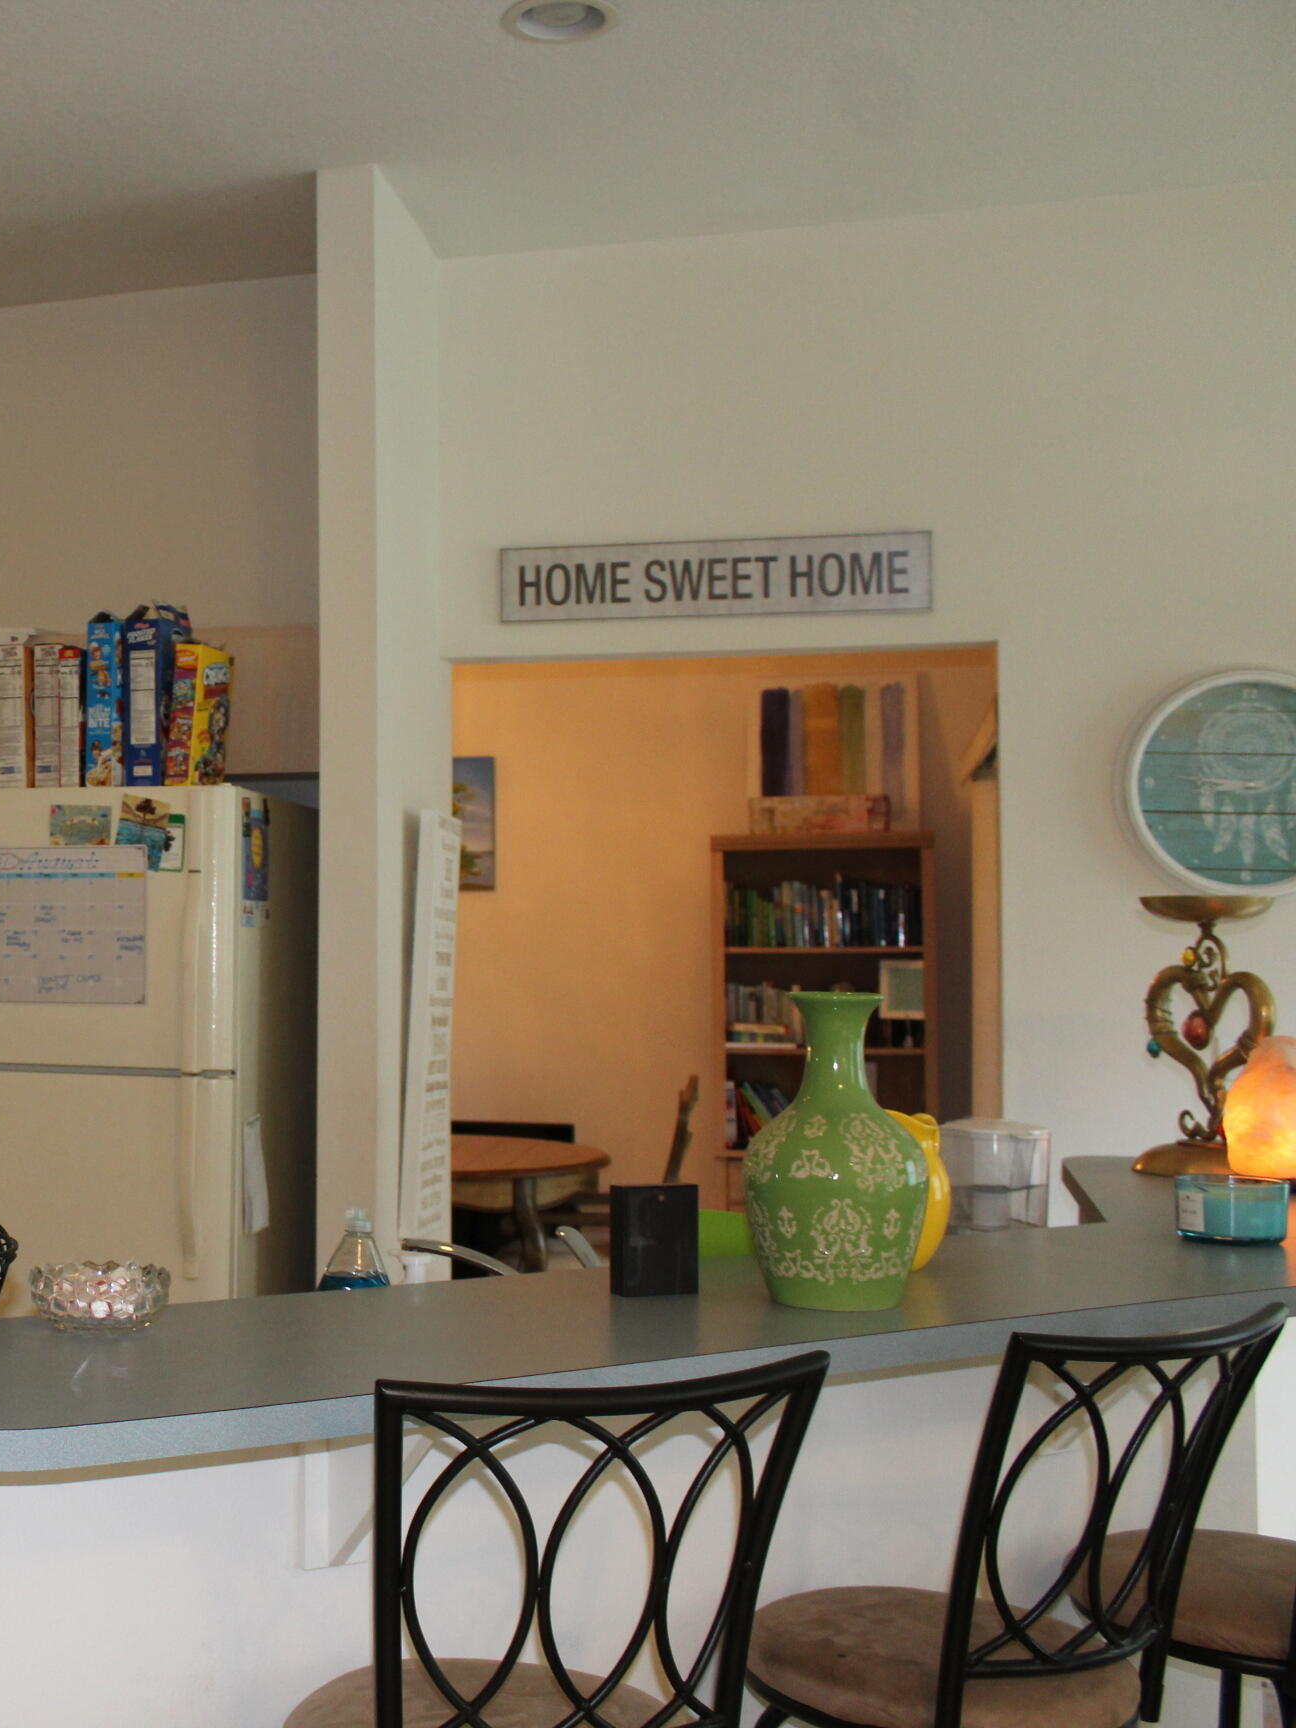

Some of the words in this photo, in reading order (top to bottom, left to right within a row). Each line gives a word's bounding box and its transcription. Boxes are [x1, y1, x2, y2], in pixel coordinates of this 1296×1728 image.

[518, 562, 632, 607] HOME
[644, 556, 779, 602] SWEET
[789, 551, 910, 597] HOME
